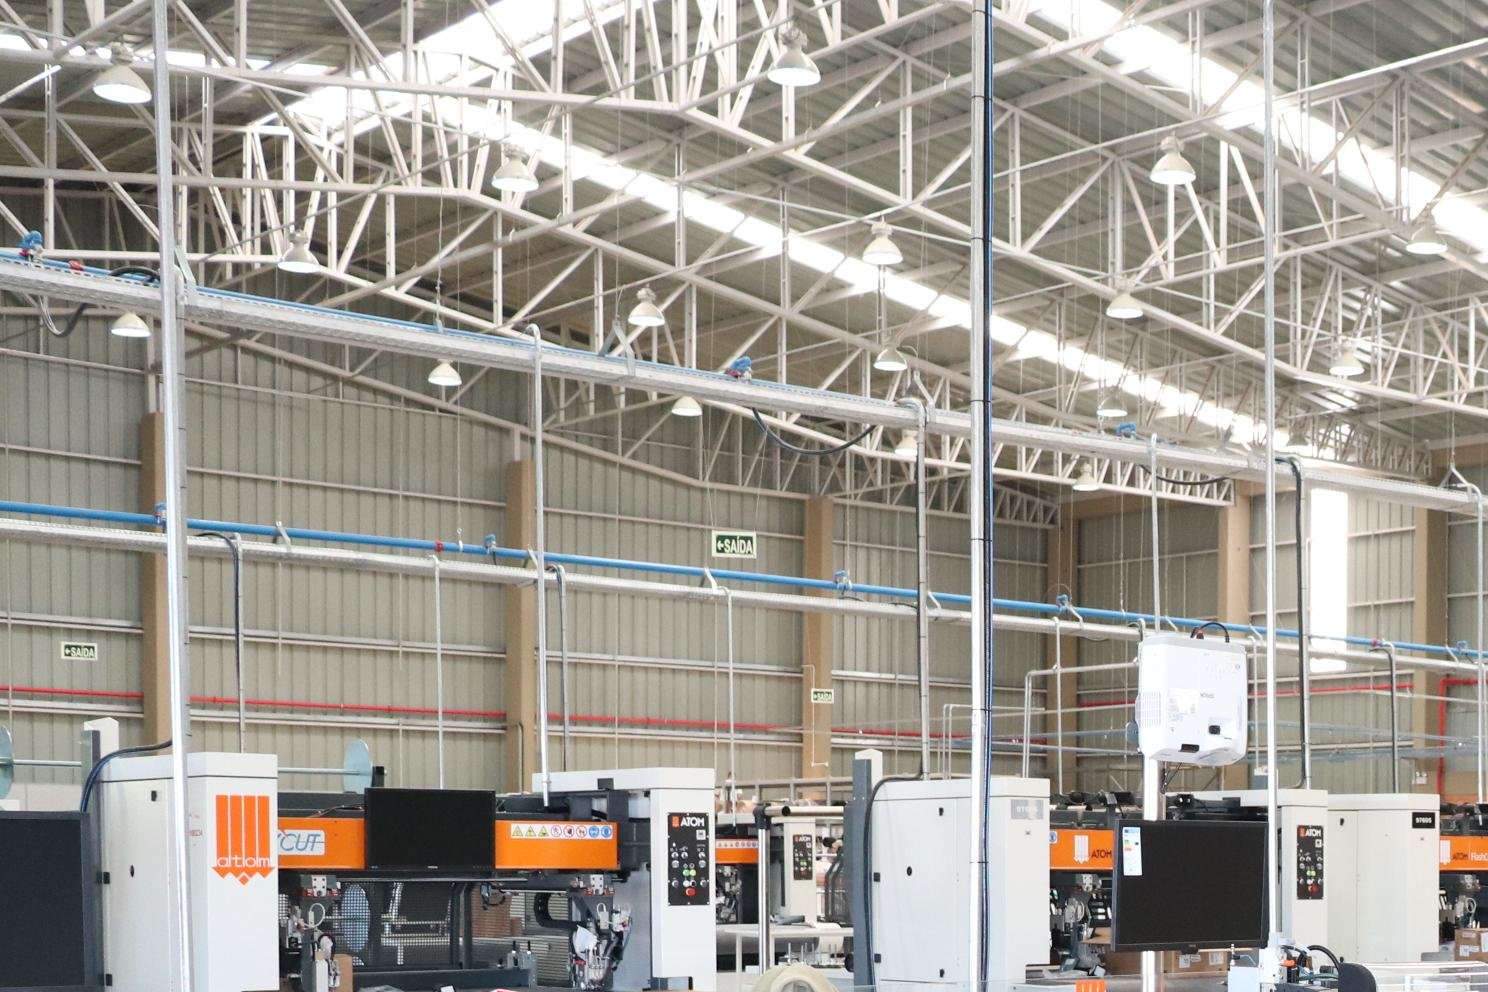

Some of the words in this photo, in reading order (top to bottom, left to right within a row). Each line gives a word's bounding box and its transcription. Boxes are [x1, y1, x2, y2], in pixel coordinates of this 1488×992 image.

[723, 535, 753, 554] SAÍDA
[70, 645, 95, 658] SAÍDA
[680, 816, 705, 827] ATOM
[1305, 828, 1322, 837] ATOM
[276, 832, 321, 852] CUT
[1091, 849, 1113, 858] ATOM
